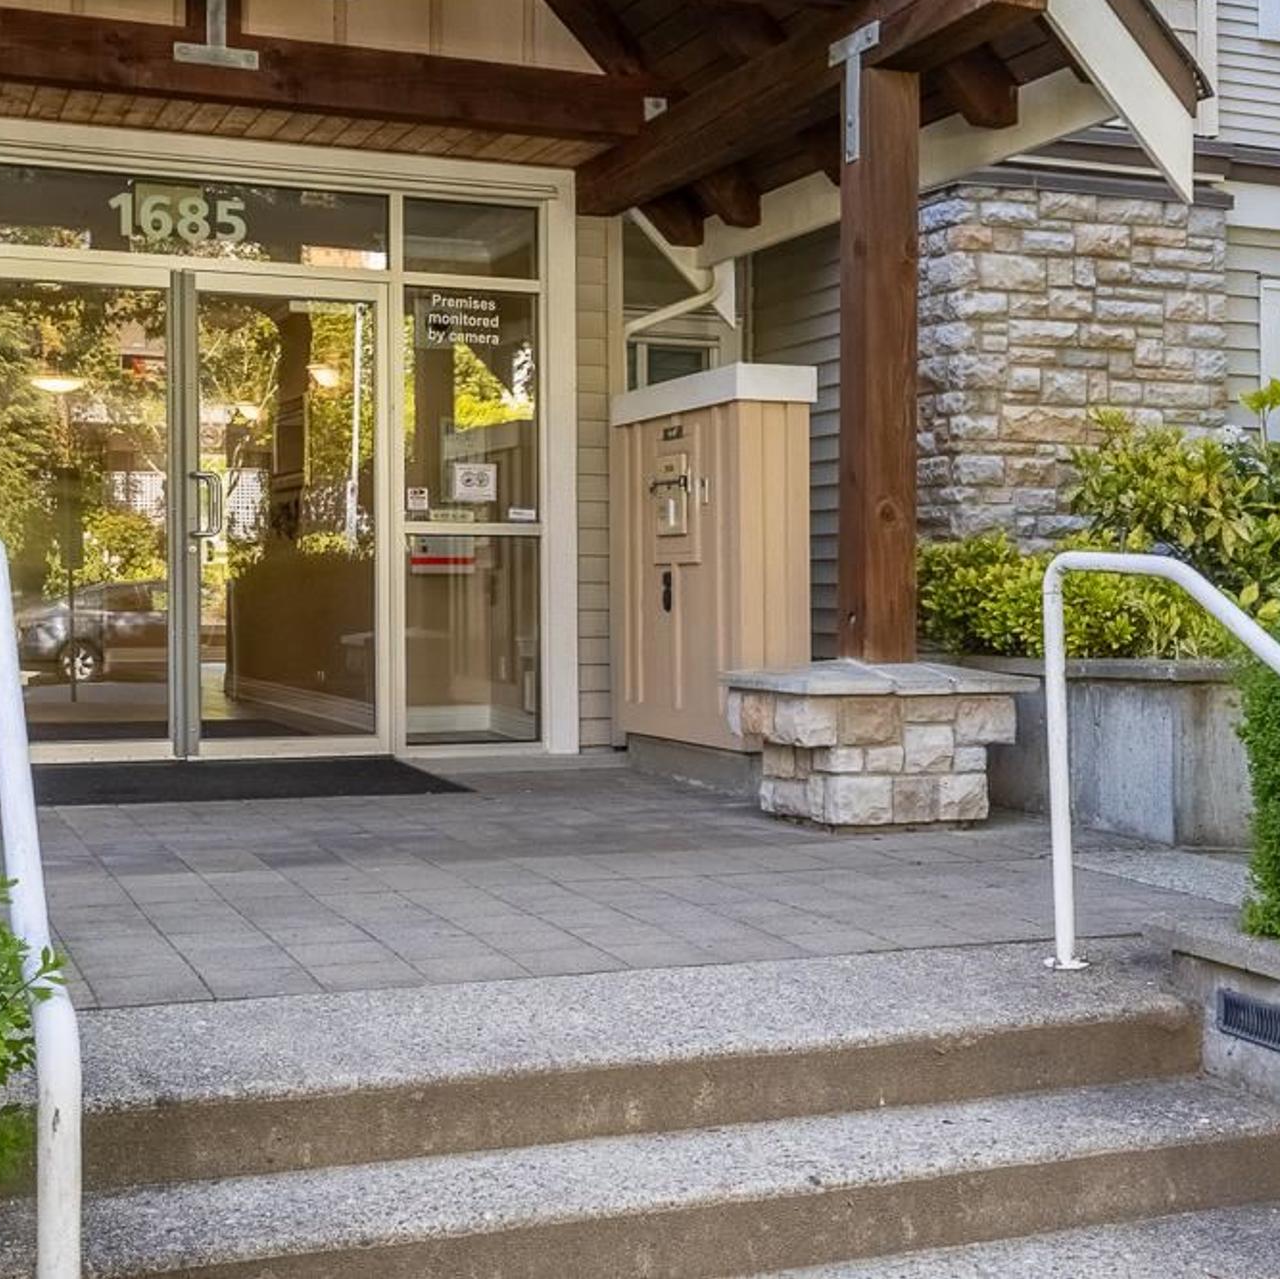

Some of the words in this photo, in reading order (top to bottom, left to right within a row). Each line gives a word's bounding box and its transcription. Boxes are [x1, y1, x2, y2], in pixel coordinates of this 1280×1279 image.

[108, 192, 247, 243] 1685
[431, 293, 496, 311] Premises
[428, 312, 500, 328] monitored
[428, 328, 446, 344] by
[449, 331, 500, 345] camera
